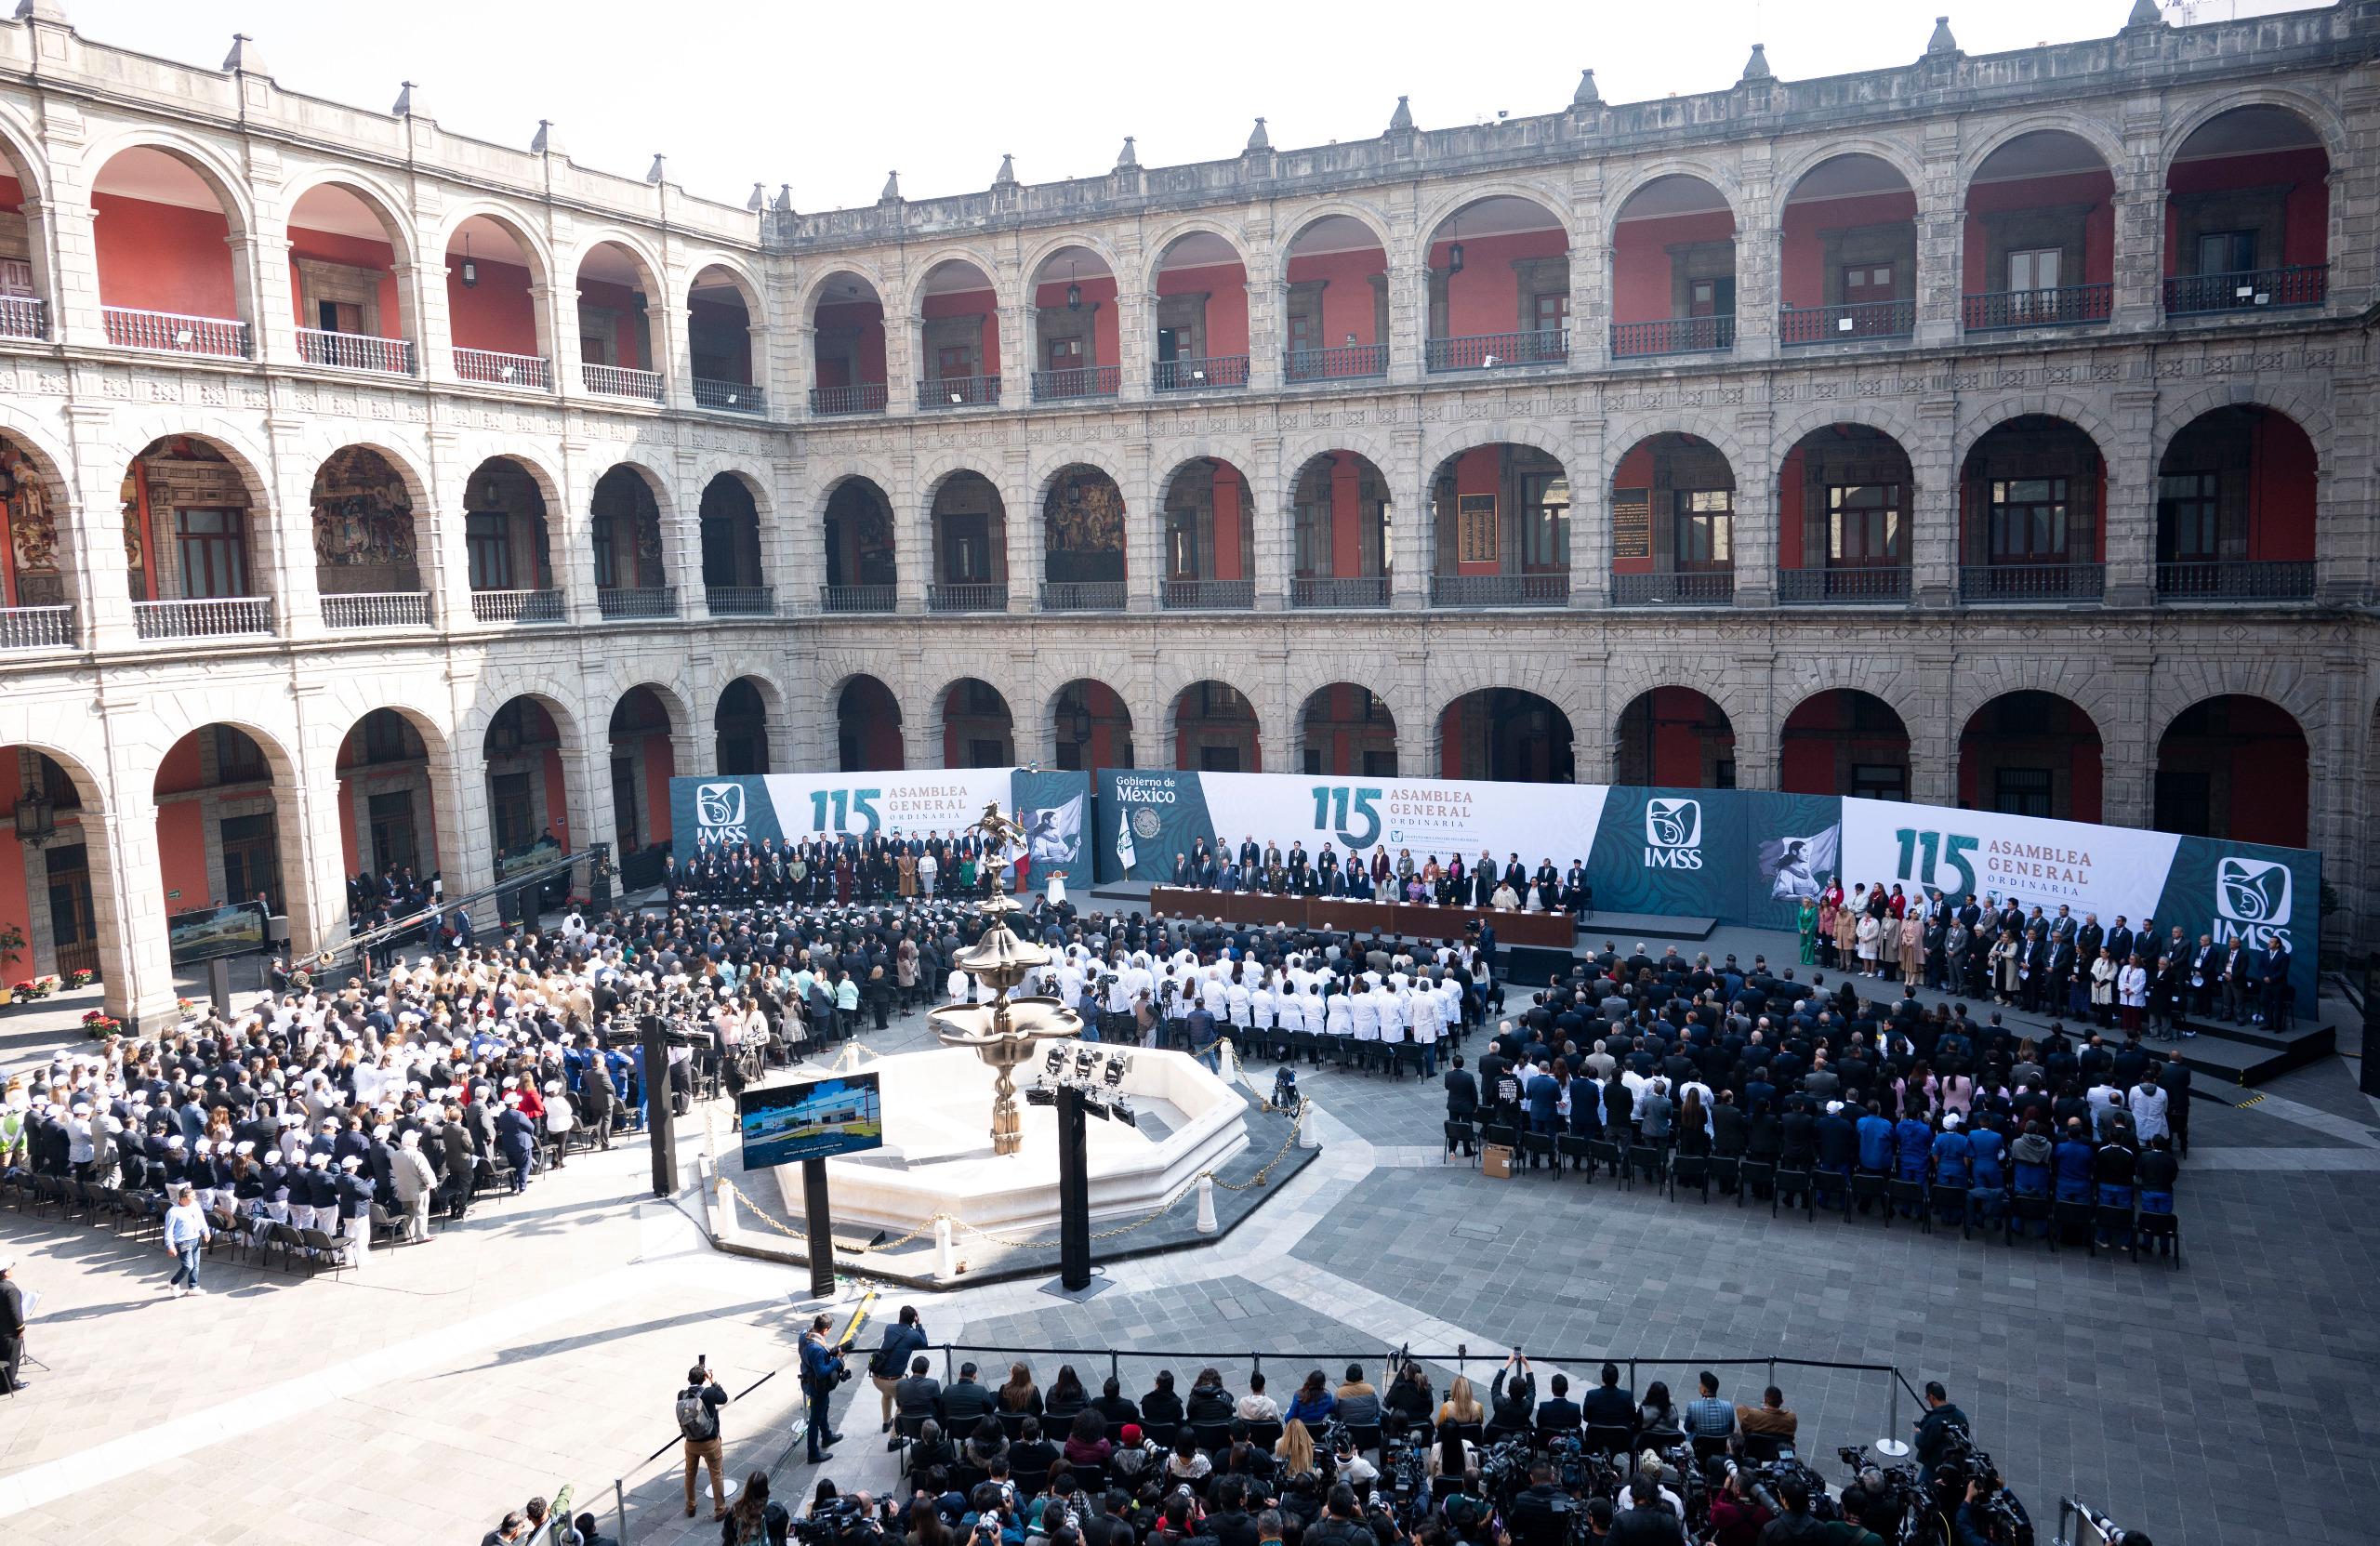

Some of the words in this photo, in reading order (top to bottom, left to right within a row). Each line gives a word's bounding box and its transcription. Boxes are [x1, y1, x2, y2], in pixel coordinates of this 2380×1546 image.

[1116, 776, 1161, 786] Gobierno
[1164, 778, 1176, 786] de
[890, 786, 968, 798] ASAMBLEA
[1117, 786, 1176, 803] México
[1390, 788, 1473, 802] ASAMBLEA
[889, 799, 966, 811] GENERAL
[1390, 803, 1471, 817] GENERAL
[811, 788, 881, 846] 115
[1312, 787, 1382, 850] 115
[1390, 818, 1464, 827] ORDINARIA
[697, 826, 747, 845] IMSS
[1645, 847, 1703, 869] IMSS
[1989, 839, 2092, 866] ASAMBLEA
[1896, 828, 1979, 908] 115
[1989, 857, 2089, 884] GENERAL
[1988, 875, 2079, 895] ORDINARIA
[2213, 918, 2293, 954] IMSS
